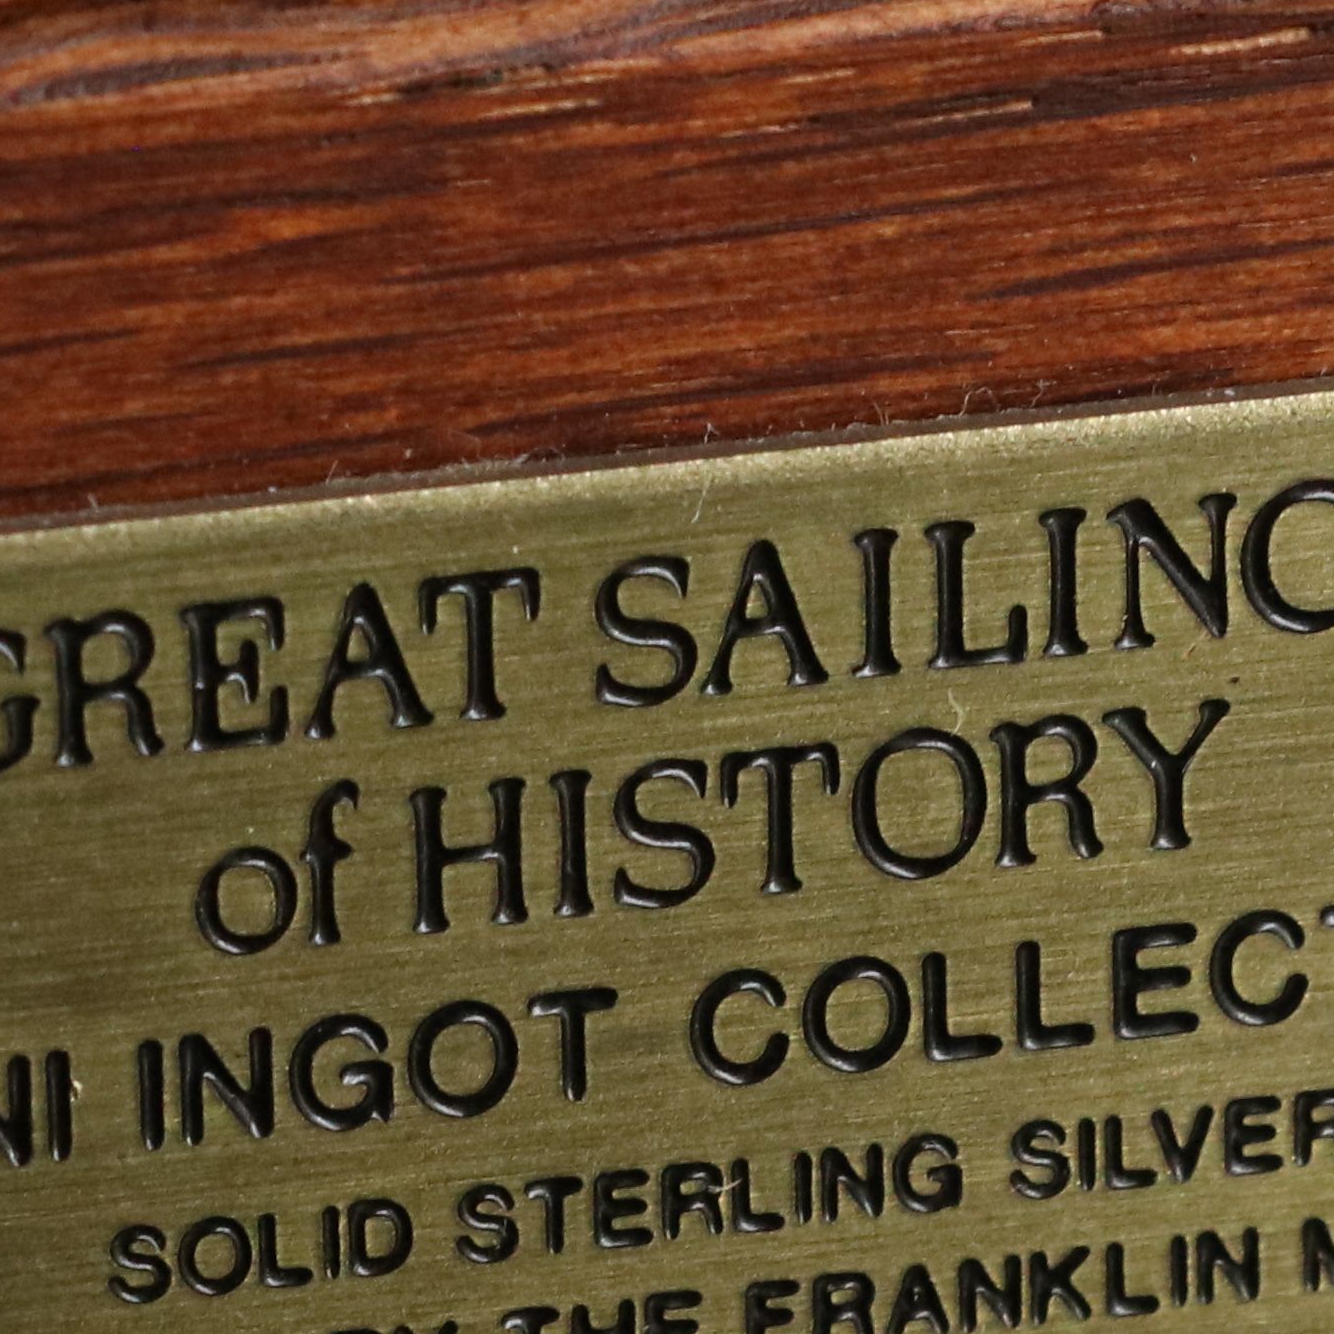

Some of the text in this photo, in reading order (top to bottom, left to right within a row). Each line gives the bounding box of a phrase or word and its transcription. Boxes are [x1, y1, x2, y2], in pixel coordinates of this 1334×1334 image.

[193, 696, 1233, 958] of HISTORY
[135, 984, 620, 1152] INGOT
[106, 1195, 415, 1306] SOLID
[453, 1130, 964, 1266] STERLING
